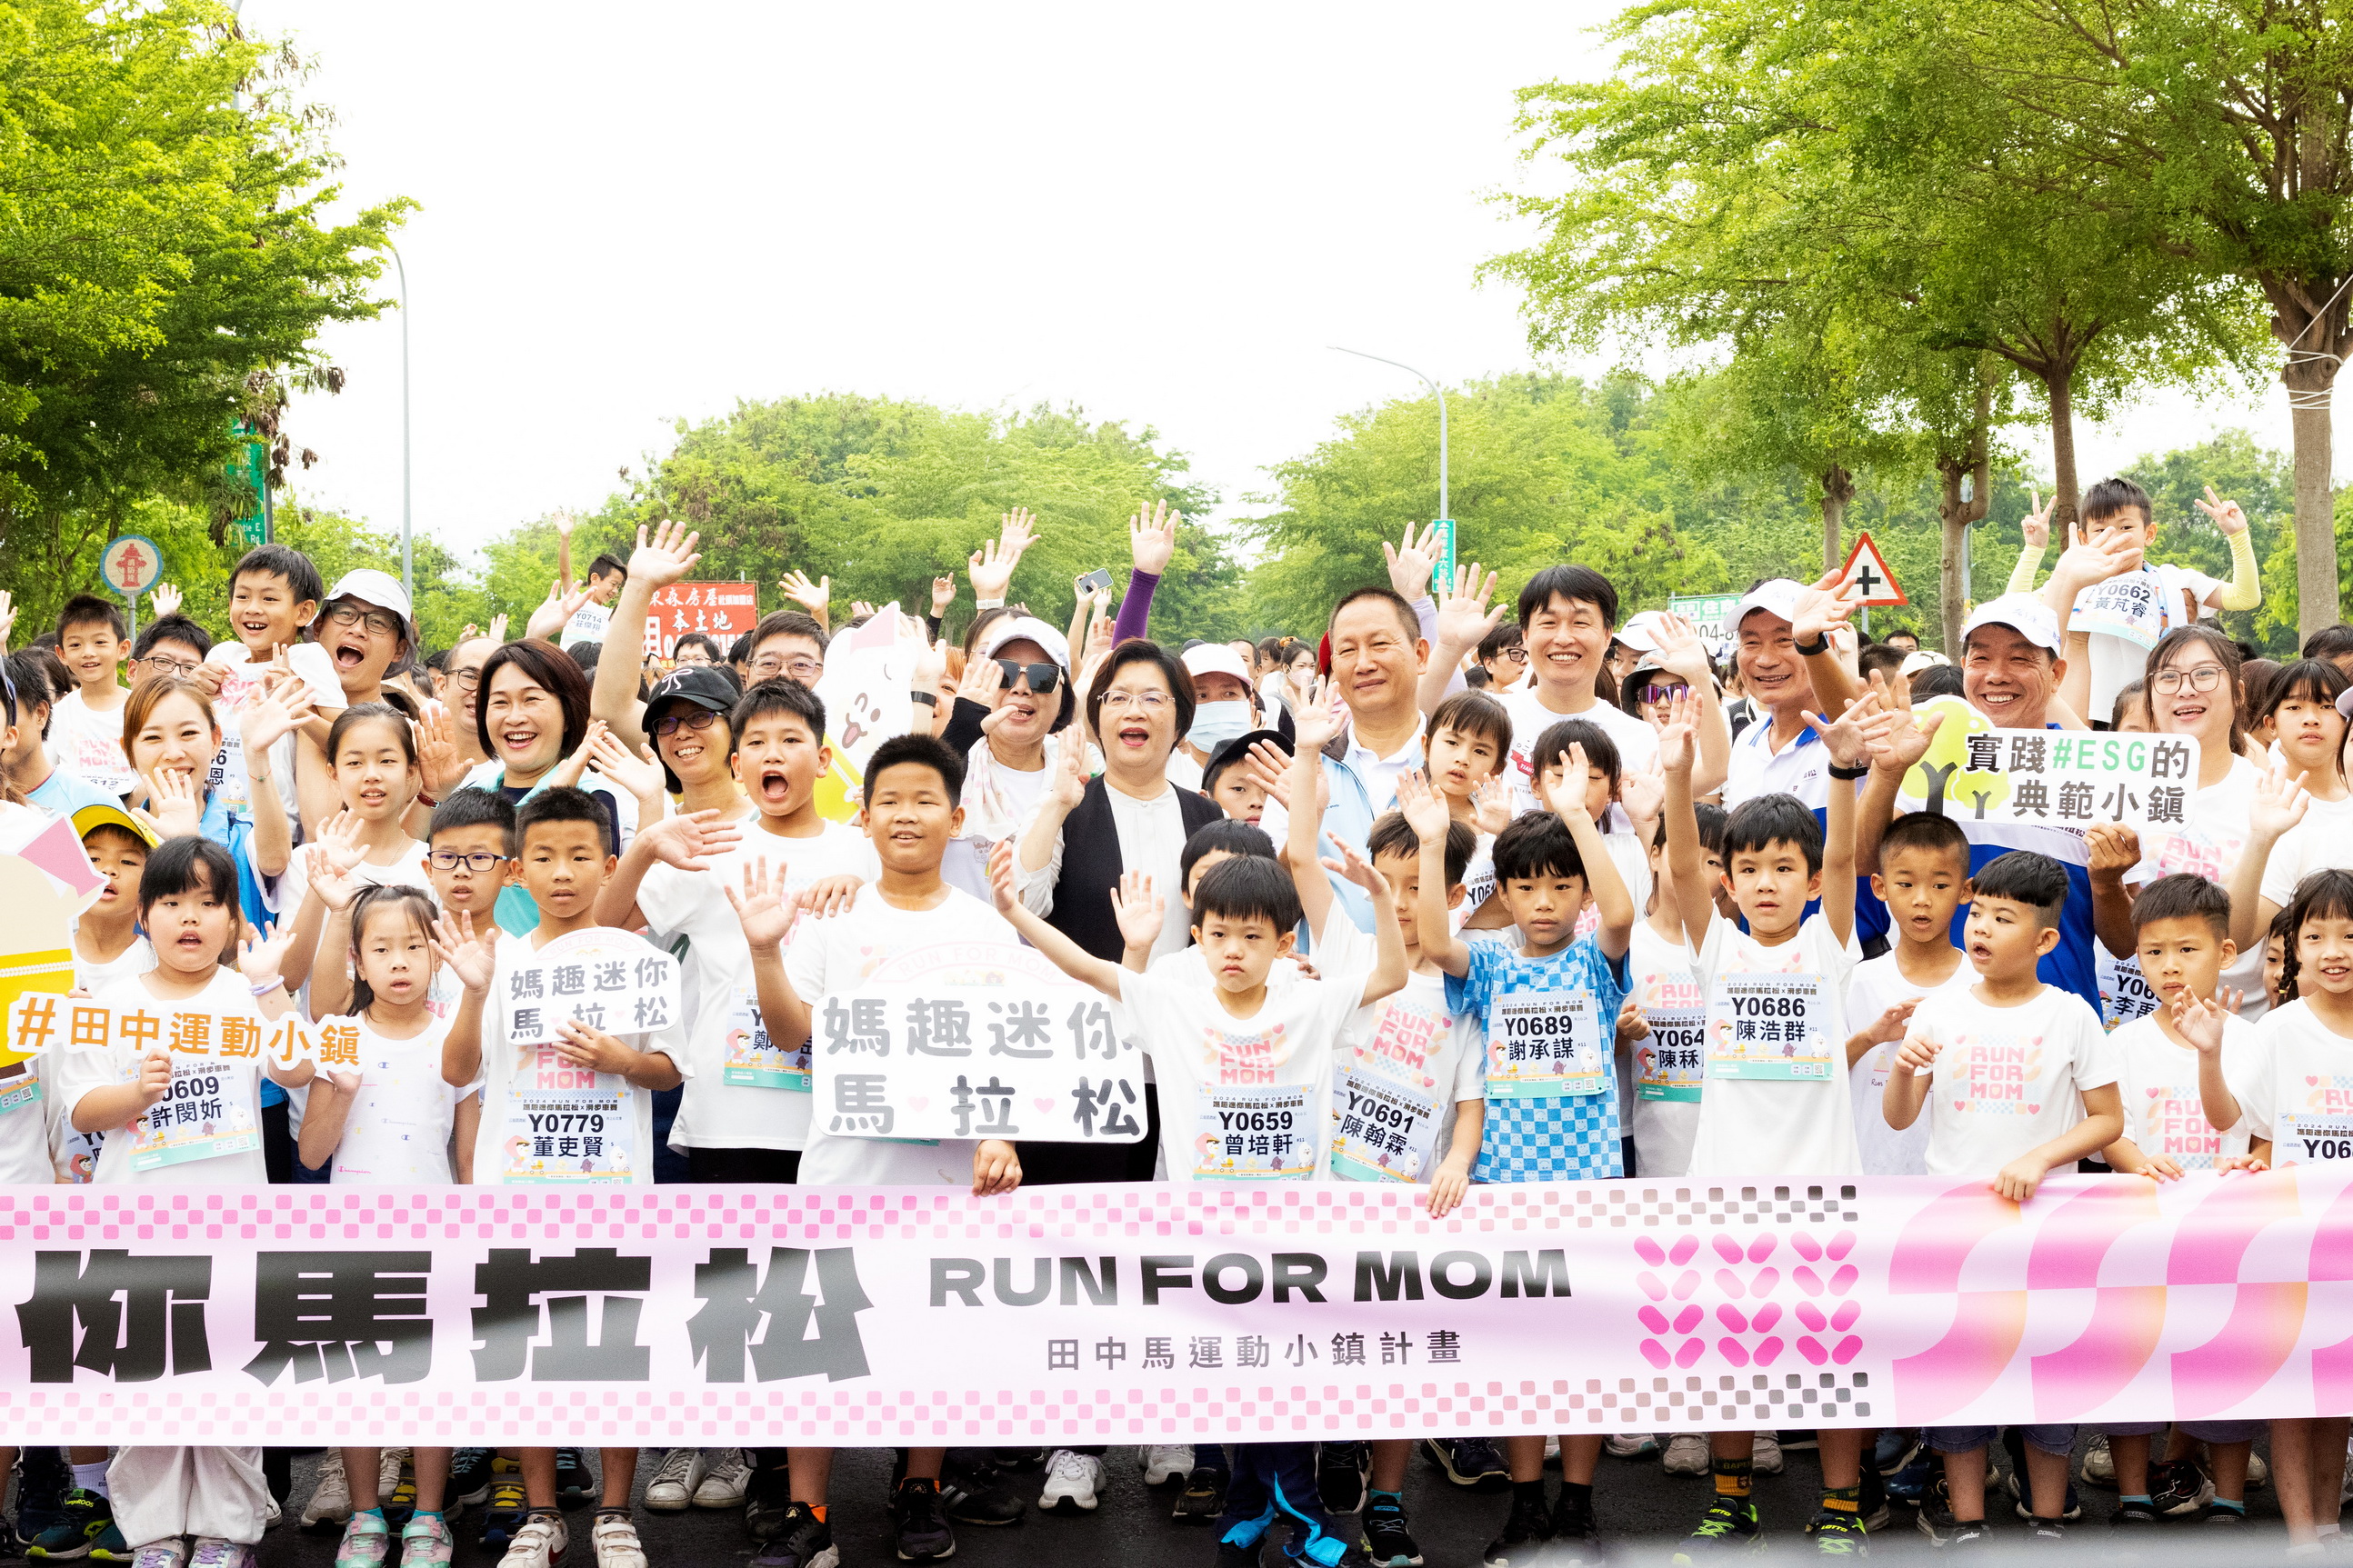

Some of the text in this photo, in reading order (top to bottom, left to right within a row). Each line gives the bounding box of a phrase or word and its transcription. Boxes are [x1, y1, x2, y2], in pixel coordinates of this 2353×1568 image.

[2097, 584, 2151, 604] Y0662
[576, 613, 602, 623] Y0714
[672, 608, 733, 633] 本土地
[1966, 733, 2190, 779] 實踐#ESG的
[2165, 836, 2222, 863] RUN
[955, 947, 995, 961] FOR
[510, 955, 668, 1002] 媽趣迷你
[1731, 997, 1806, 1017] Y0686
[823, 997, 1135, 1060] 媽趣迷你
[1385, 1003, 1437, 1037] RUN
[1505, 1015, 1573, 1036] Y0689
[1737, 1019, 1806, 1042] 陳浩群
[1220, 1040, 1272, 1056] RUN
[1378, 1022, 1428, 1053] FOR
[1653, 1029, 1705, 1047] Y064
[1372, 1035, 1427, 1071] MOM
[1509, 1037, 1574, 1061] 謝承謀
[1658, 1049, 1704, 1069] 陳秝
[1970, 1046, 2025, 1063] RUN
[537, 1071, 595, 1089] MOM
[1220, 1069, 1275, 1084] MOM
[1970, 1065, 2025, 1081] FOR
[162, 1075, 219, 1102] 0609
[1970, 1084, 2024, 1100] MOM
[151, 1097, 223, 1129] 許閔妡
[1348, 1091, 1415, 1134] Y0691
[2164, 1099, 2205, 1116] RU
[528, 1114, 604, 1133] Y0779
[1218, 1111, 1293, 1131] Y0659
[1226, 1134, 1293, 1155] 曾培軒
[1340, 1114, 1407, 1156] 陳翰霖
[2164, 1137, 2221, 1154] MOM
[533, 1136, 603, 1157] 董吏賢
[2303, 1139, 2353, 1159] Y06
[928, 1248, 1573, 1307] RUN FOR MOM
[15, 1246, 872, 1387] 你馬拉松
[1046, 1329, 1464, 1372] 田中馬運動小鎮計畫
[1821, 1524, 1848, 1533] LOTTO
[1957, 1532, 1980, 1543] combat
